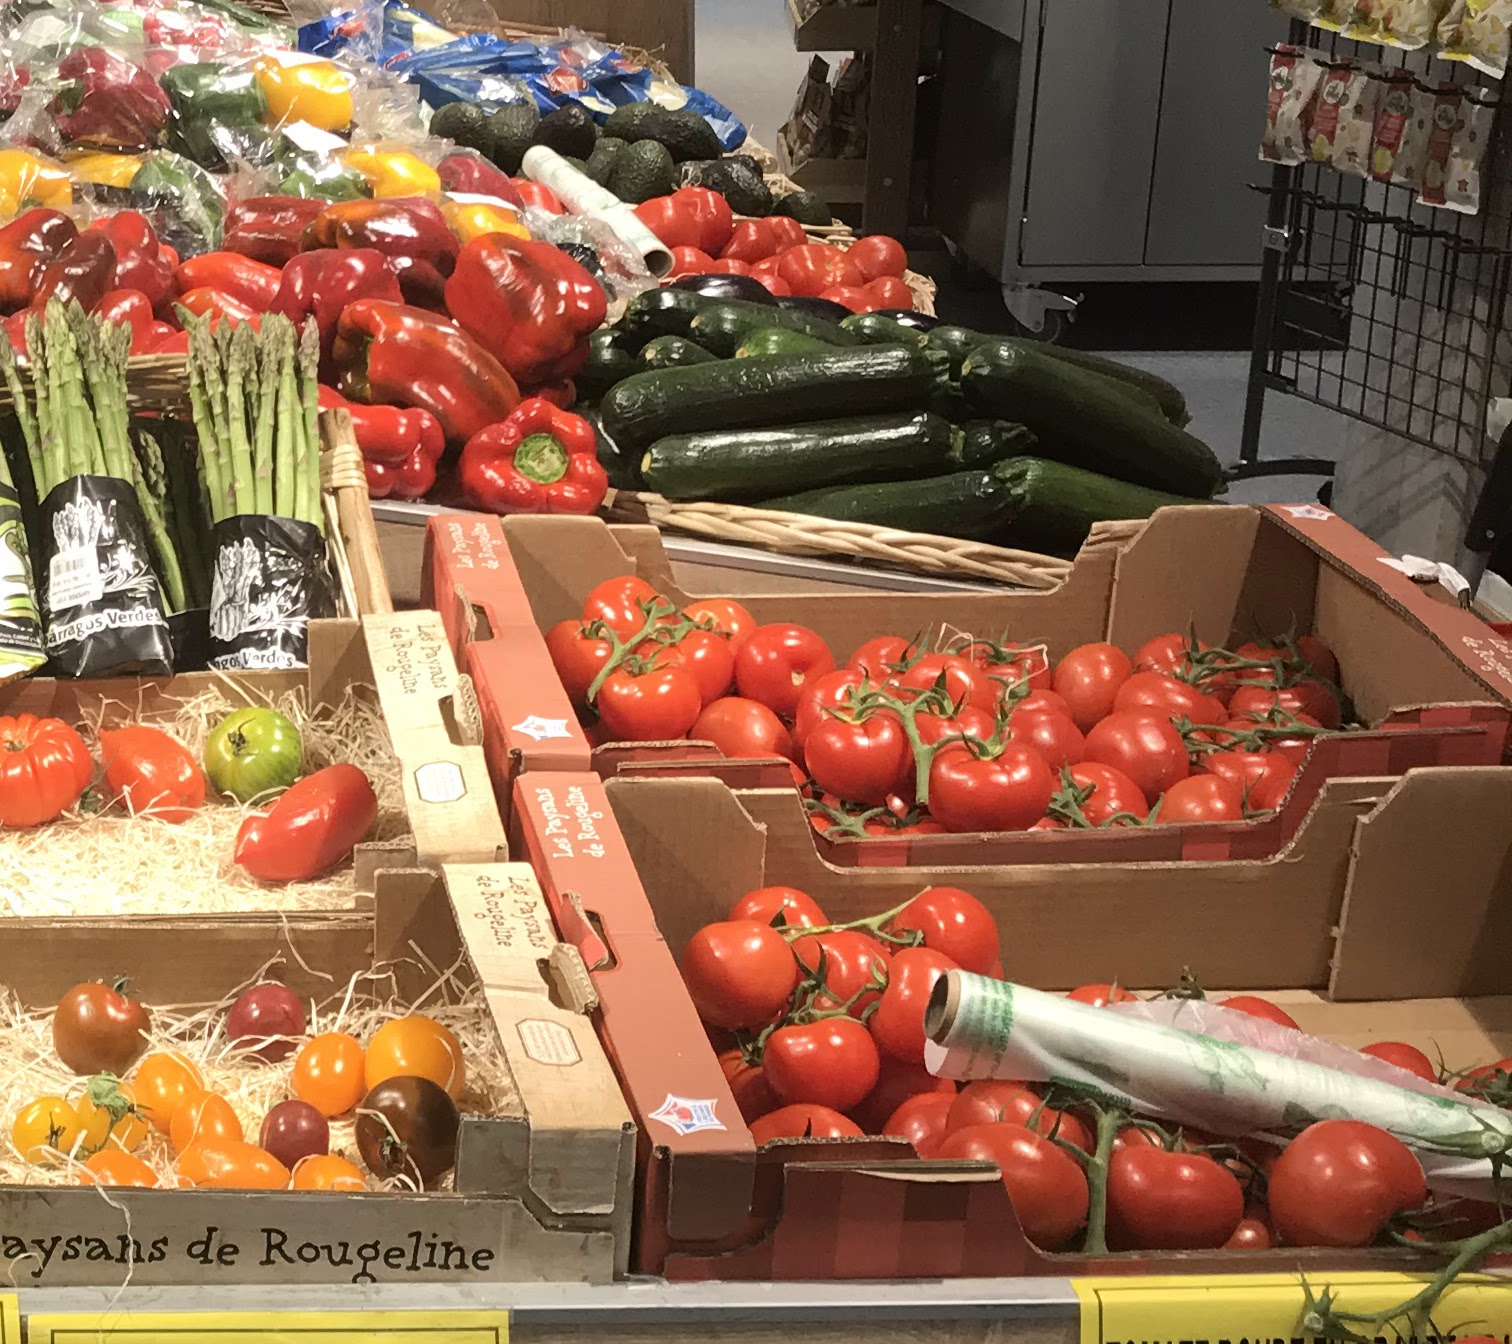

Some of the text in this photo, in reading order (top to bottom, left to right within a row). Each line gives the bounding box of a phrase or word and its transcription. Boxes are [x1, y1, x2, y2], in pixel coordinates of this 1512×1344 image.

[535, 787, 574, 858] Les Paysans
[566, 786, 605, 858] de Rougeline
[474, 875, 516, 947] de Rougeline
[508, 876, 548, 949] Les Paysans
[187, 1226, 240, 1267] de
[258, 1227, 496, 1284] Rougeline
